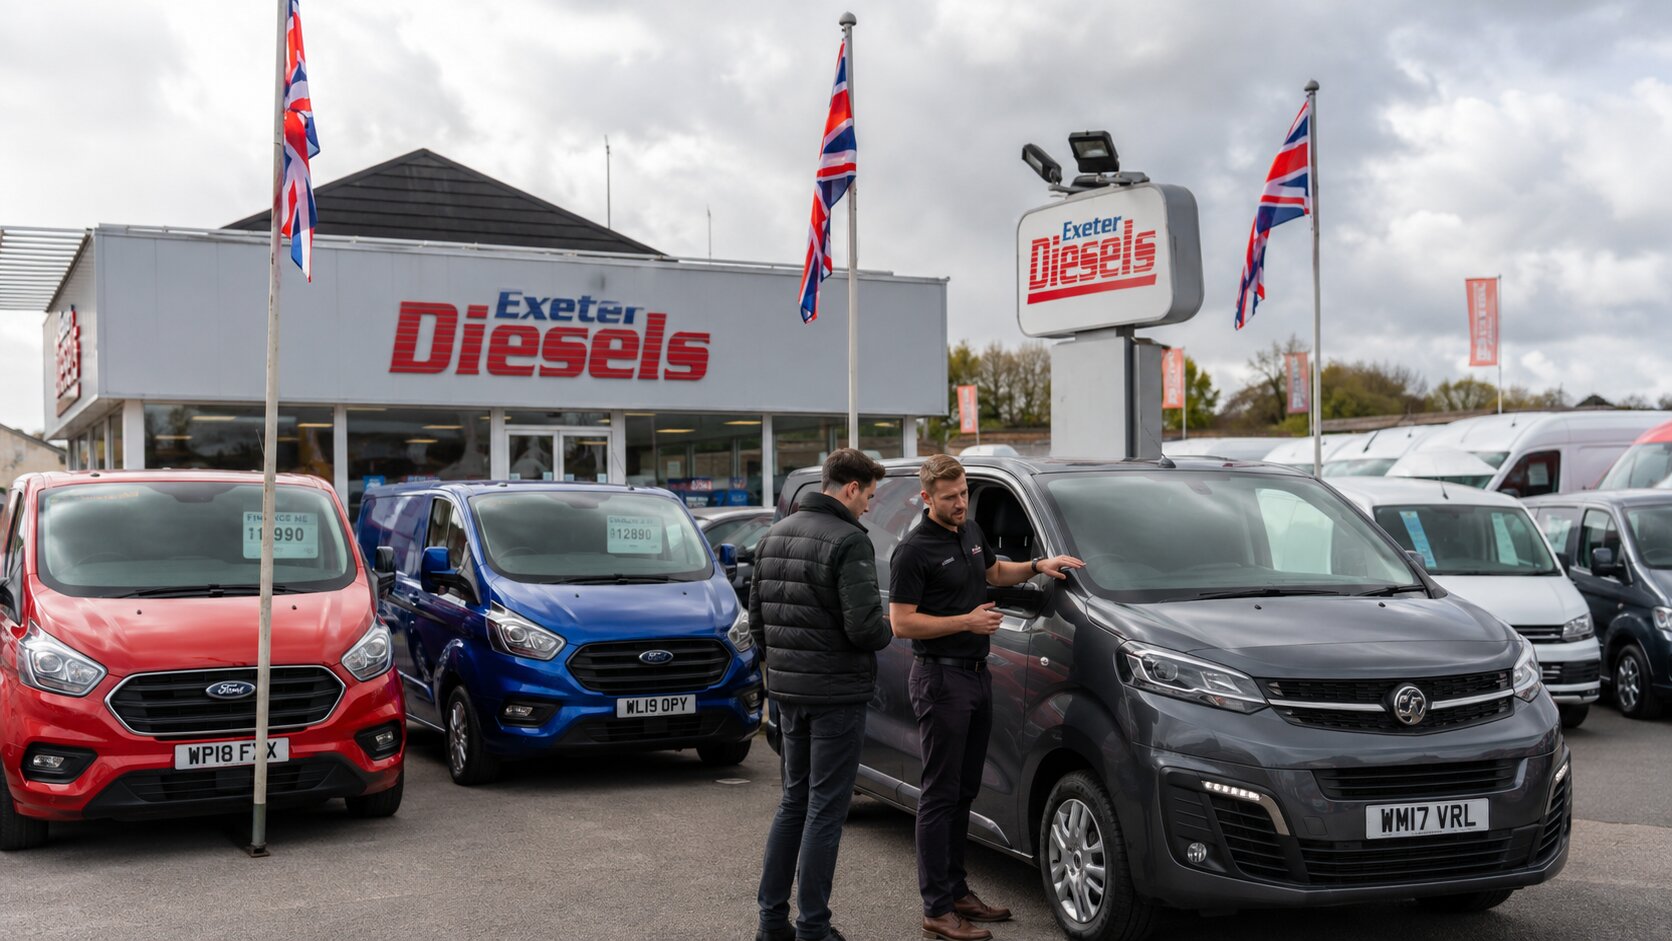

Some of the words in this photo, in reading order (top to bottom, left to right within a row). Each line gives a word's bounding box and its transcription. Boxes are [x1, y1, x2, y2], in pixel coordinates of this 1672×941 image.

[1062, 215, 1122, 242] Exeter
[1028, 218, 1157, 291] Diesels
[494, 288, 644, 325] Exeter
[388, 301, 711, 381] Diesels
[626, 699, 658, 715] WL19
[661, 696, 688, 712] OPY
[188, 745, 233, 765] WP18
[239, 741, 277, 762] FX
[1380, 805, 1430, 833] WM17
[1436, 803, 1477, 830] VRL
